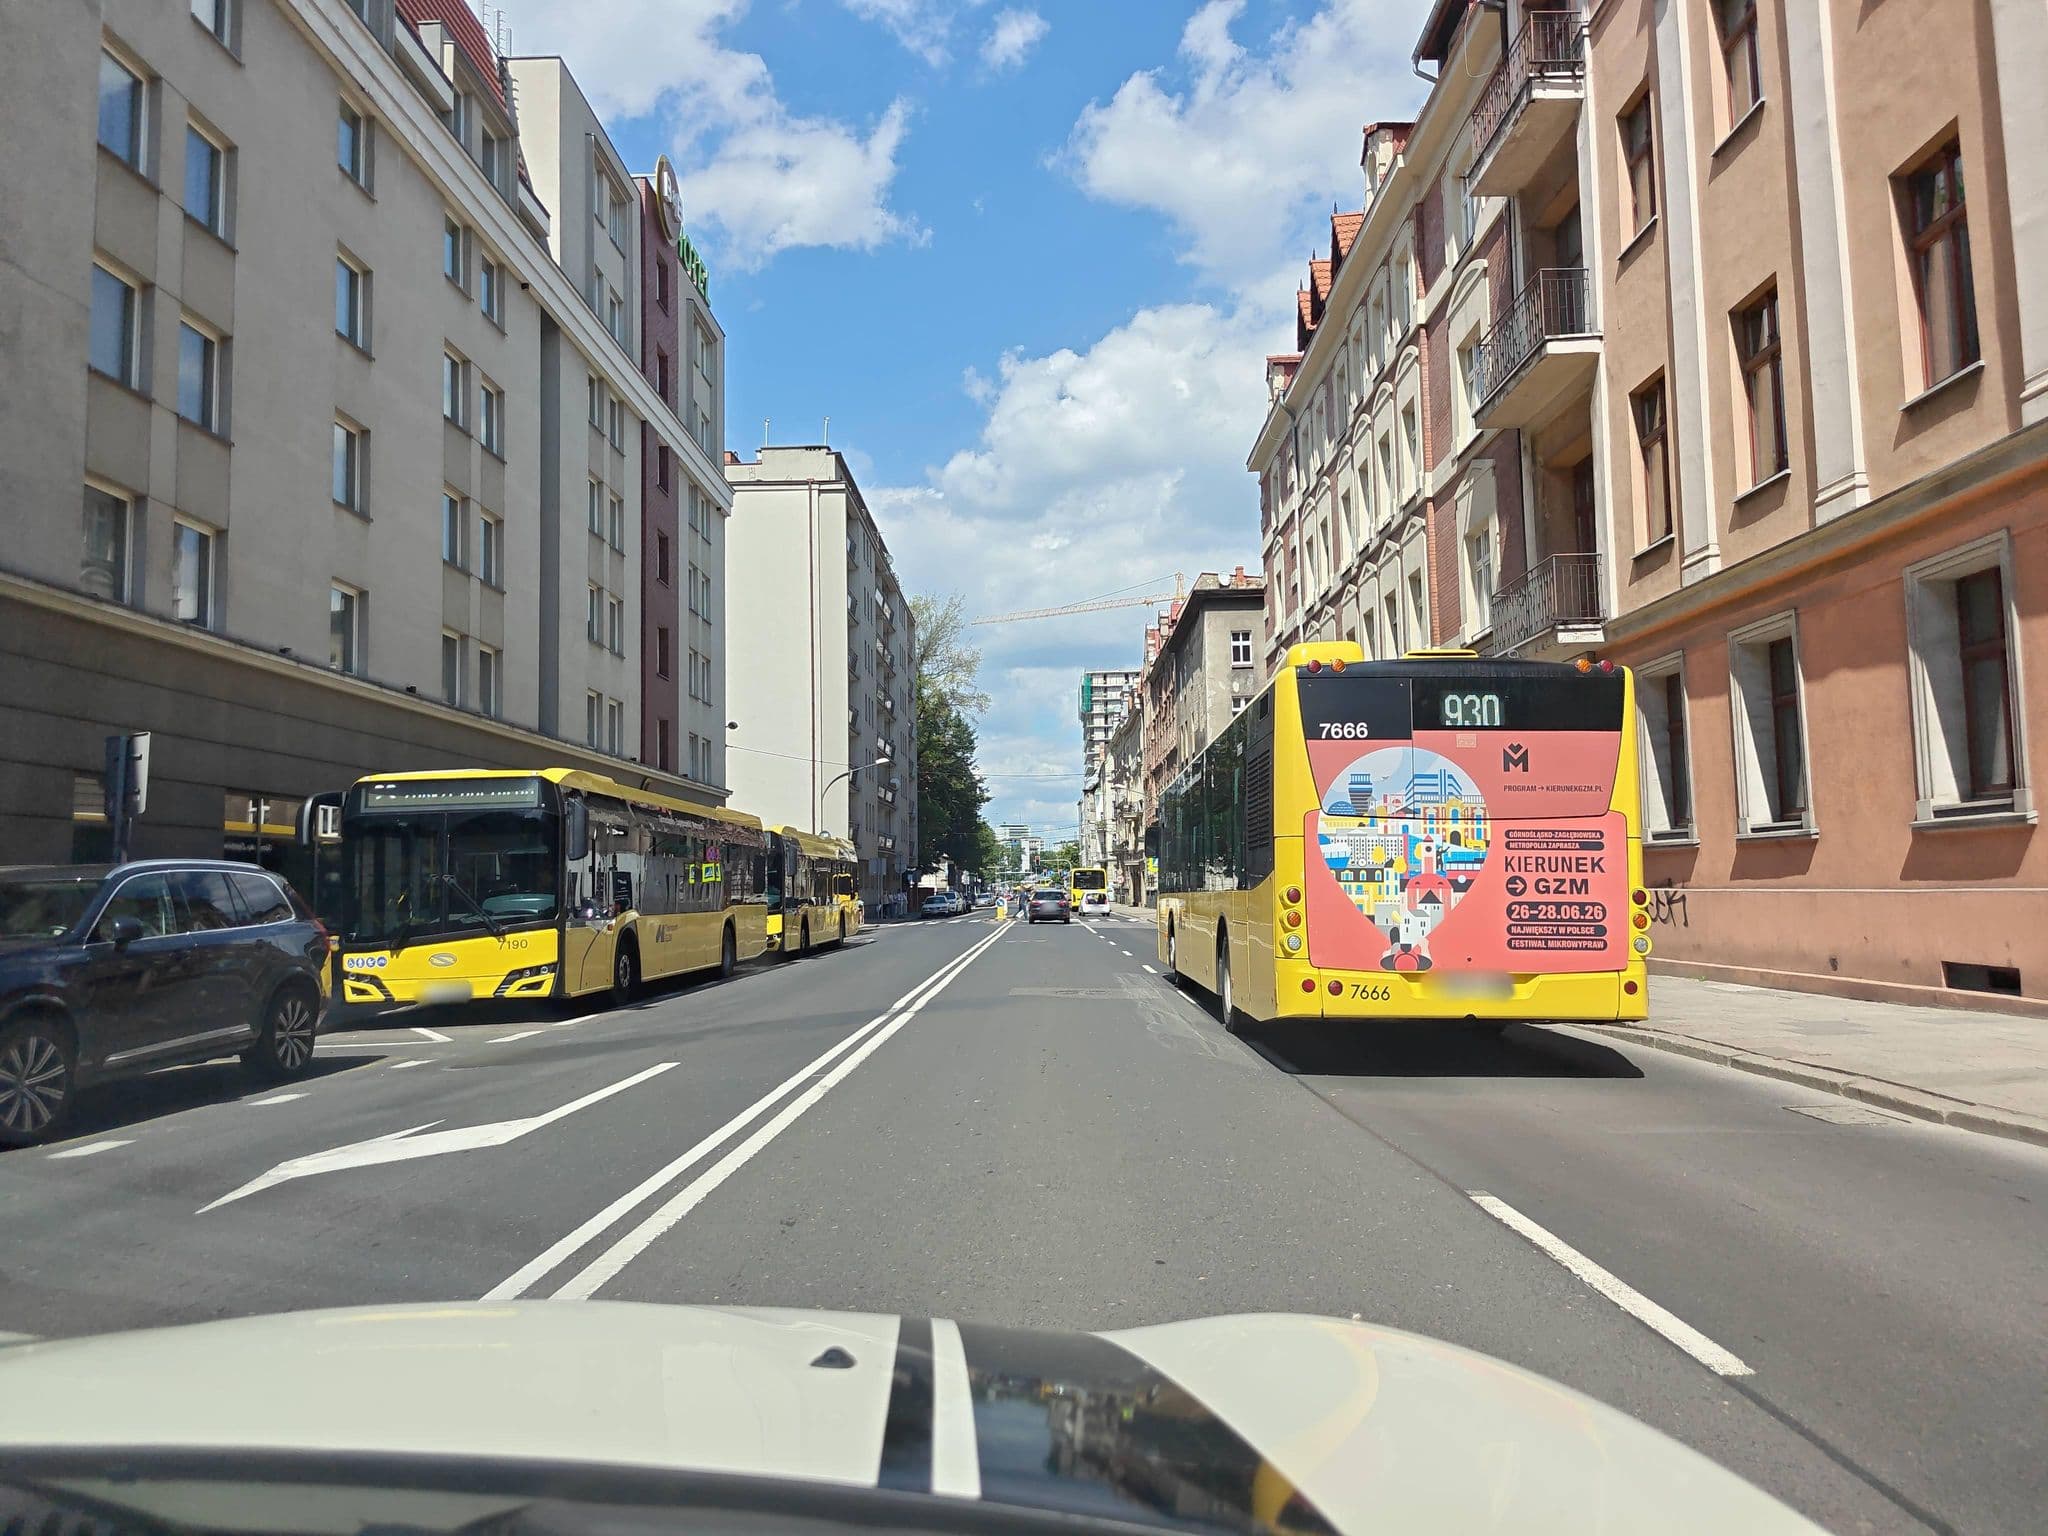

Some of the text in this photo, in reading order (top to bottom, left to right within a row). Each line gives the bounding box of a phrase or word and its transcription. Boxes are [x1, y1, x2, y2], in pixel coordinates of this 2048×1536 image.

[1445, 694, 1500, 726] 930
[1319, 722, 1368, 739] 7666
[1503, 784, 1604, 793] PROGRAM KIERUNEKGZM.PL
[1509, 841, 1581, 850] METROPOLIA ZAPRASZA
[1504, 855, 1606, 873] KIERUNEK
[1534, 878, 1589, 895] GZM
[1511, 905, 1603, 920] 26-28.06.26
[1511, 925, 1595, 936] NAJWIĘKSZY W POLSCE
[498, 938, 528, 950] 7190
[1511, 938, 1604, 949] FESTIWAL MIKROWYPRAW
[1351, 983, 1391, 1001] 7666
